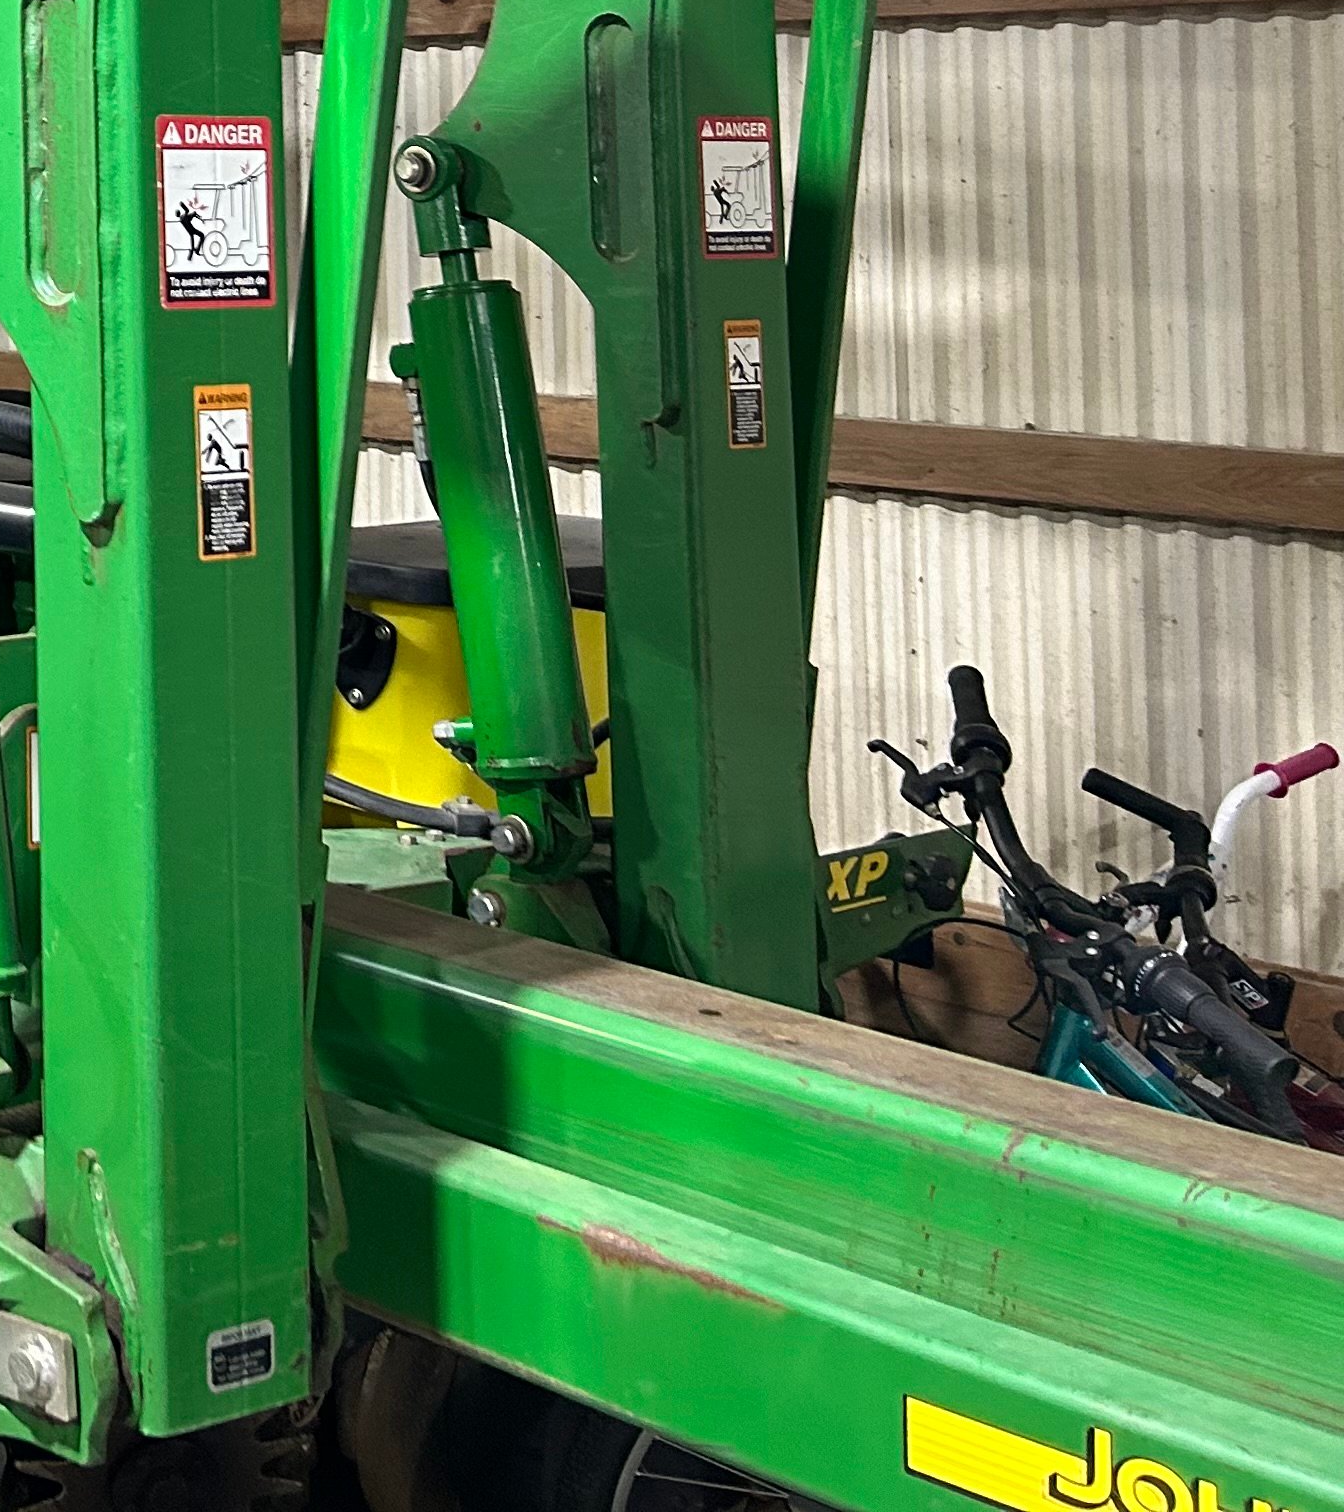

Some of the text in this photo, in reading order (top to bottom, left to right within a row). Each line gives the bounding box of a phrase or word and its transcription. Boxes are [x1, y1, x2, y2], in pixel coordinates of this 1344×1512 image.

[184, 123, 263, 145] DANGER
[715, 121, 767, 138] DANGER
[207, 392, 248, 404] WARNING
[826, 849, 890, 902] XP
